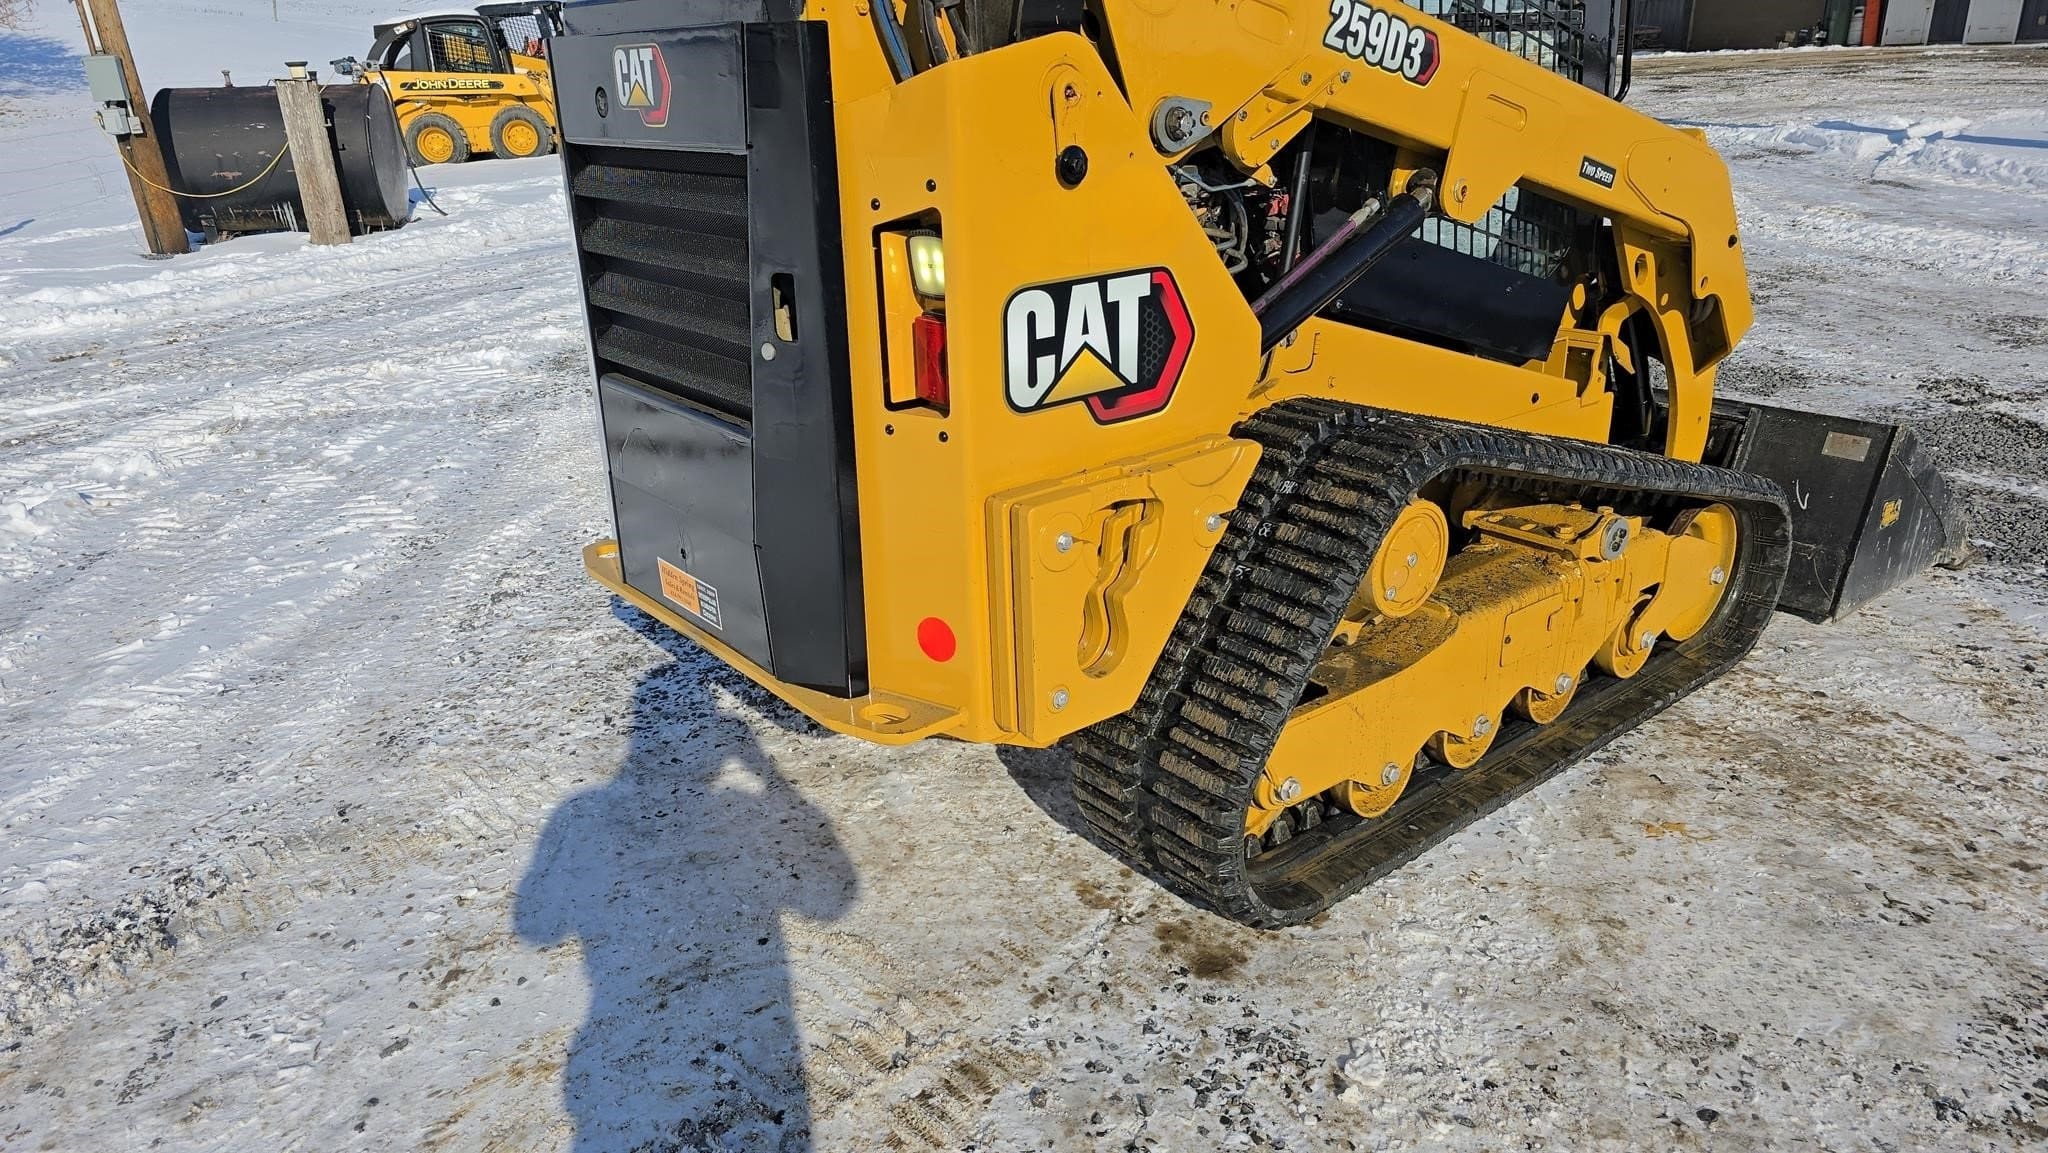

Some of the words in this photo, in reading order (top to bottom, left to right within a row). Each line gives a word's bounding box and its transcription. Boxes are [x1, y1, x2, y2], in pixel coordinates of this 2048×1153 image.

[1325, 0, 1426, 78] 259D3
[412, 79, 447, 90] JOHN
[447, 78, 491, 89] DEERE
[614, 47, 655, 106] CAT
[1007, 272, 1151, 408] CAT
